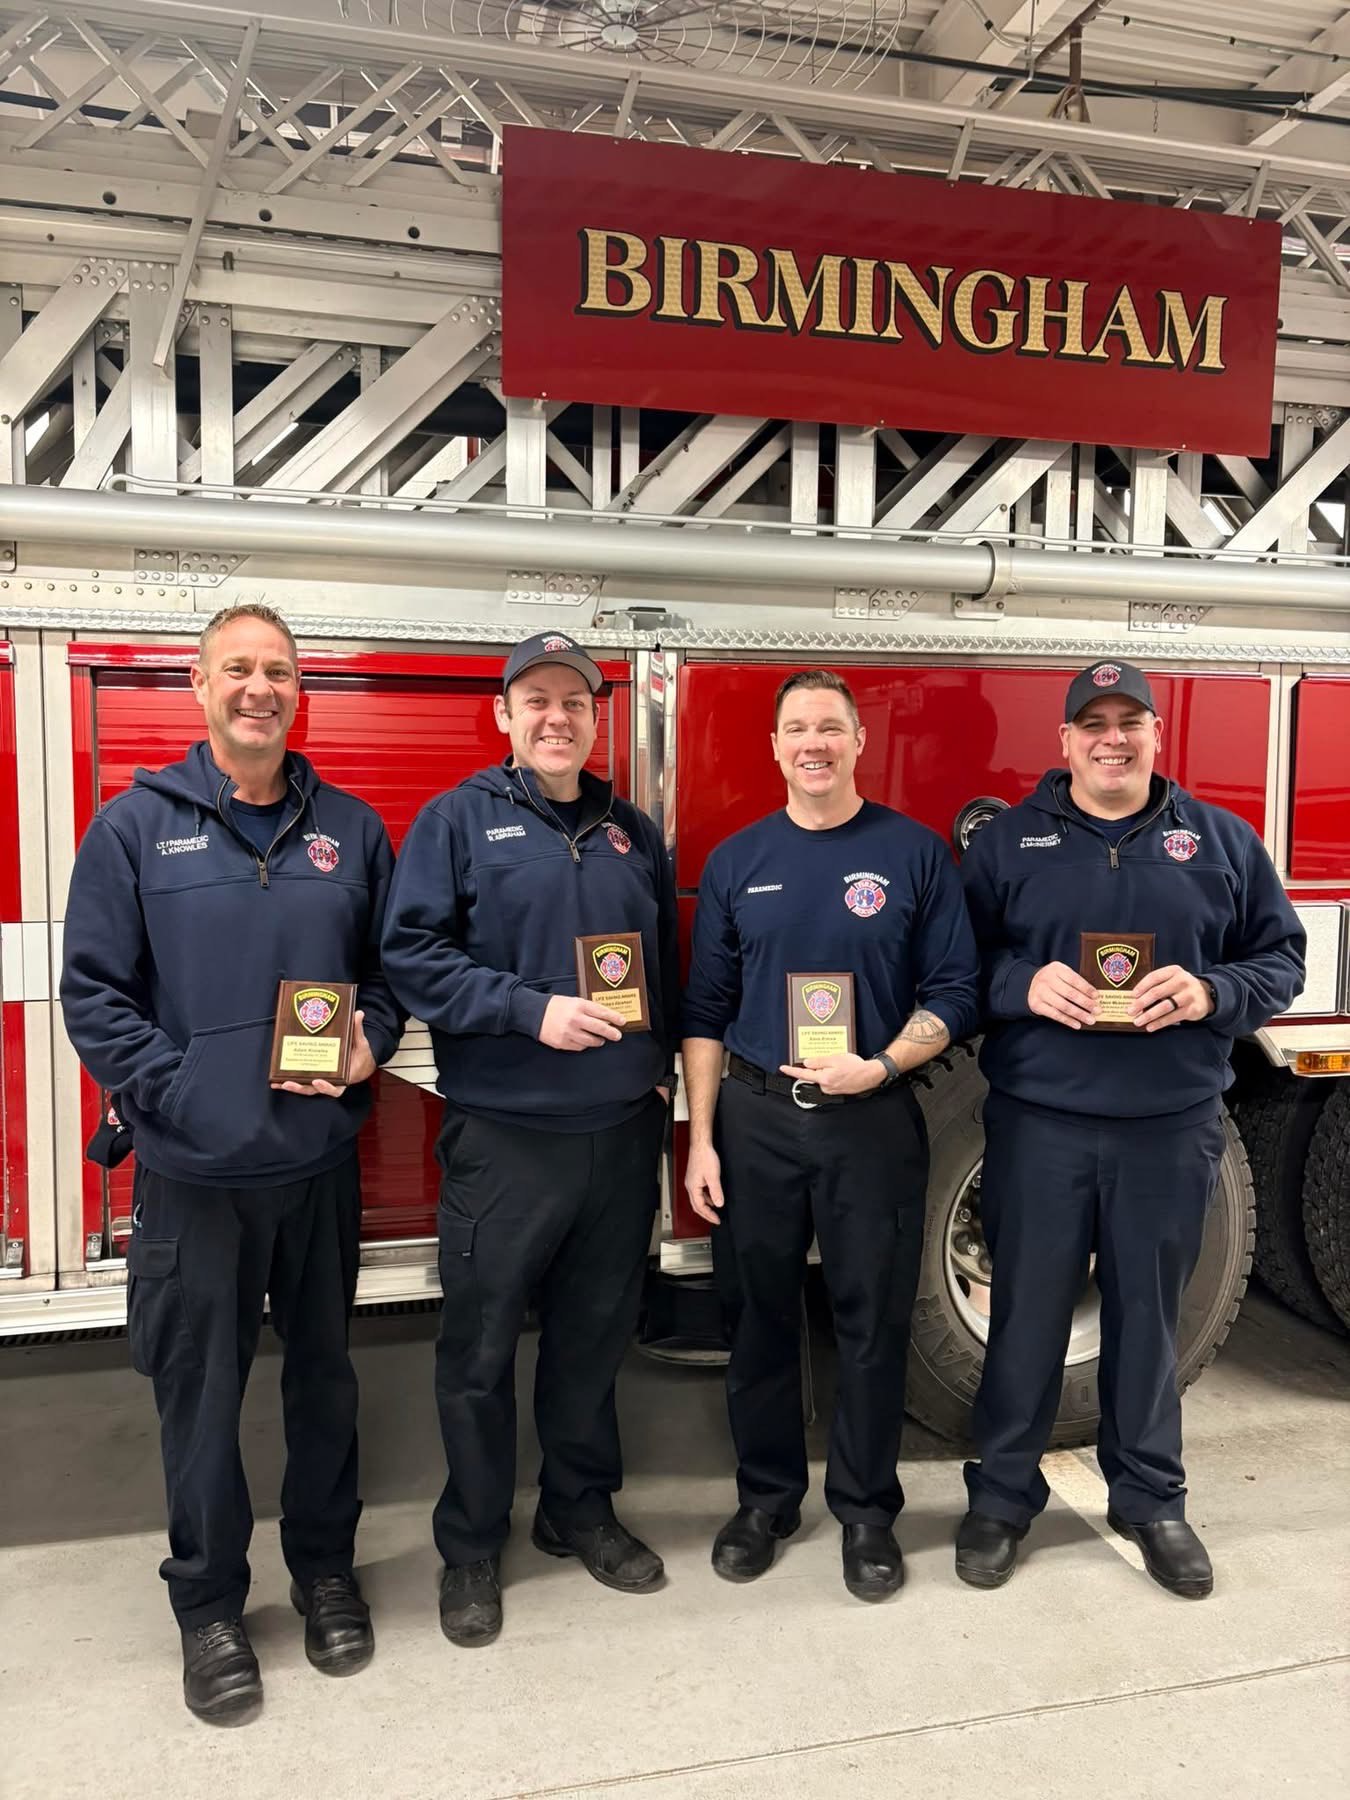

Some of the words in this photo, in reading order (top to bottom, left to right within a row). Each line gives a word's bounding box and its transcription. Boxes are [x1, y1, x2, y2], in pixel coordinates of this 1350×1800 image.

[576, 226, 1228, 374] BIRMINGHAM
[486, 825, 524, 837] PARAMEDIC
[843, 871, 890, 887] BIRMINGHAM
[747, 883, 783, 894] PARAMEDIC
[1100, 946, 1136, 957] BIRMINGHAM
